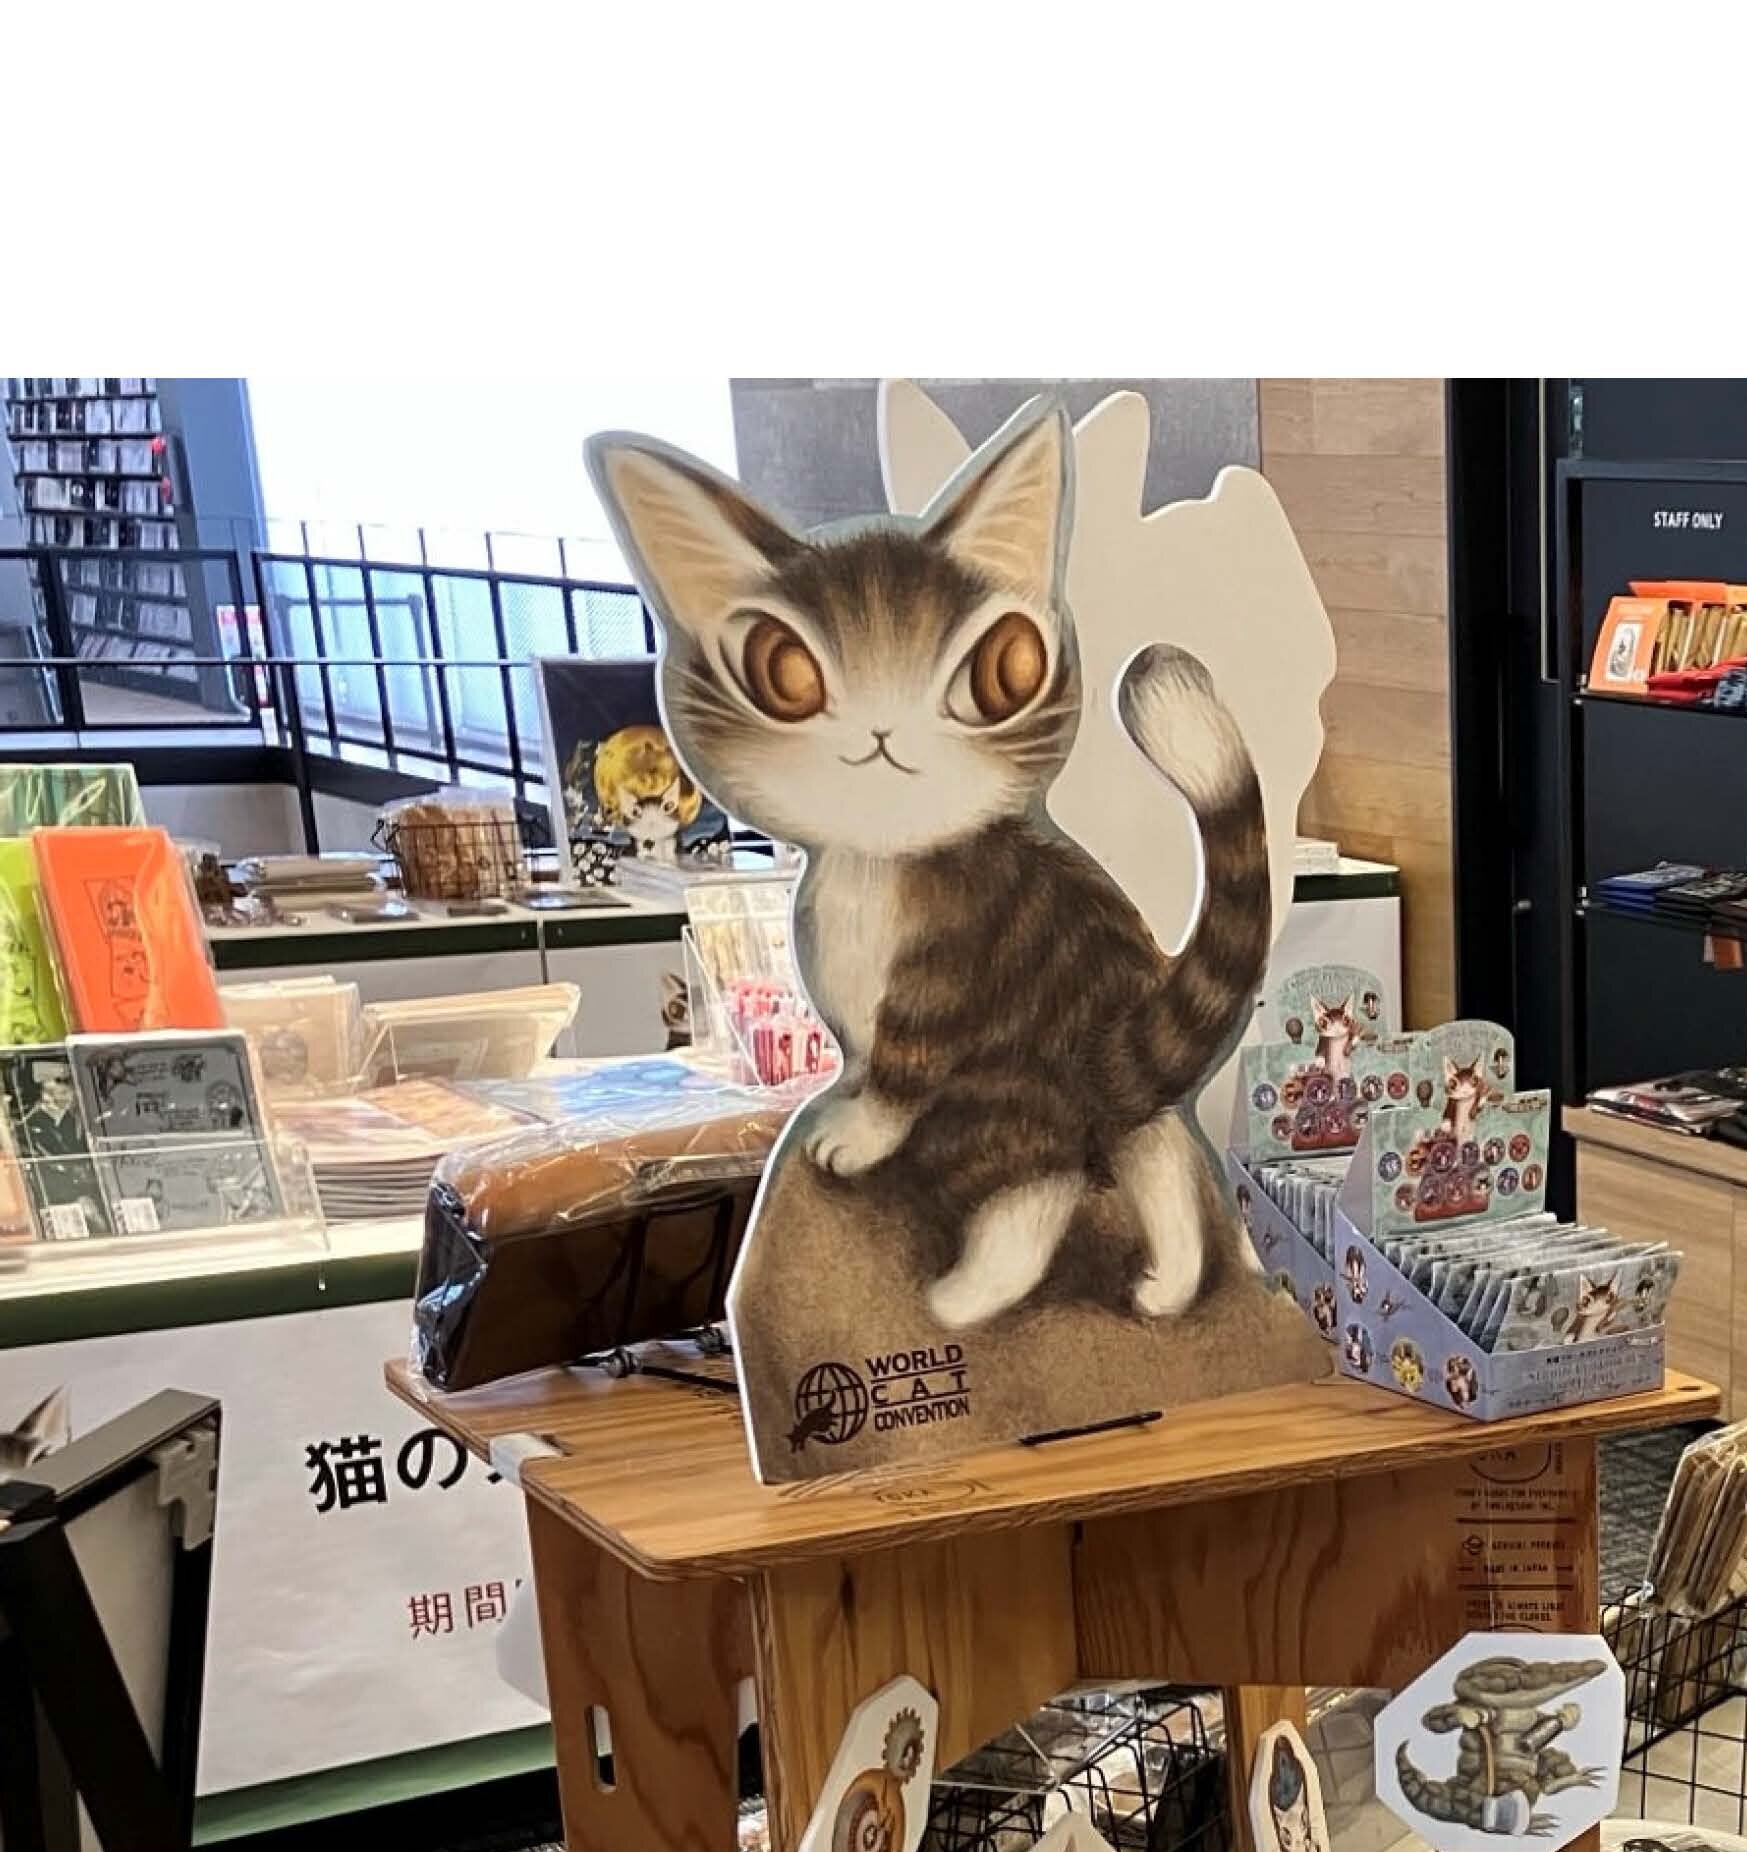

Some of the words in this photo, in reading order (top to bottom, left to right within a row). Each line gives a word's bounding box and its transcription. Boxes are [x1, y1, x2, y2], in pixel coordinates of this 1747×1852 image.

[1654, 511, 1690, 528] STAFF
[1692, 512, 1723, 530] ONLY
[865, 1344, 963, 1377] WORLD
[874, 1395, 970, 1432] CONVENTION
[305, 1424, 501, 1513] 猫の
[407, 1579, 523, 1640] 期間
